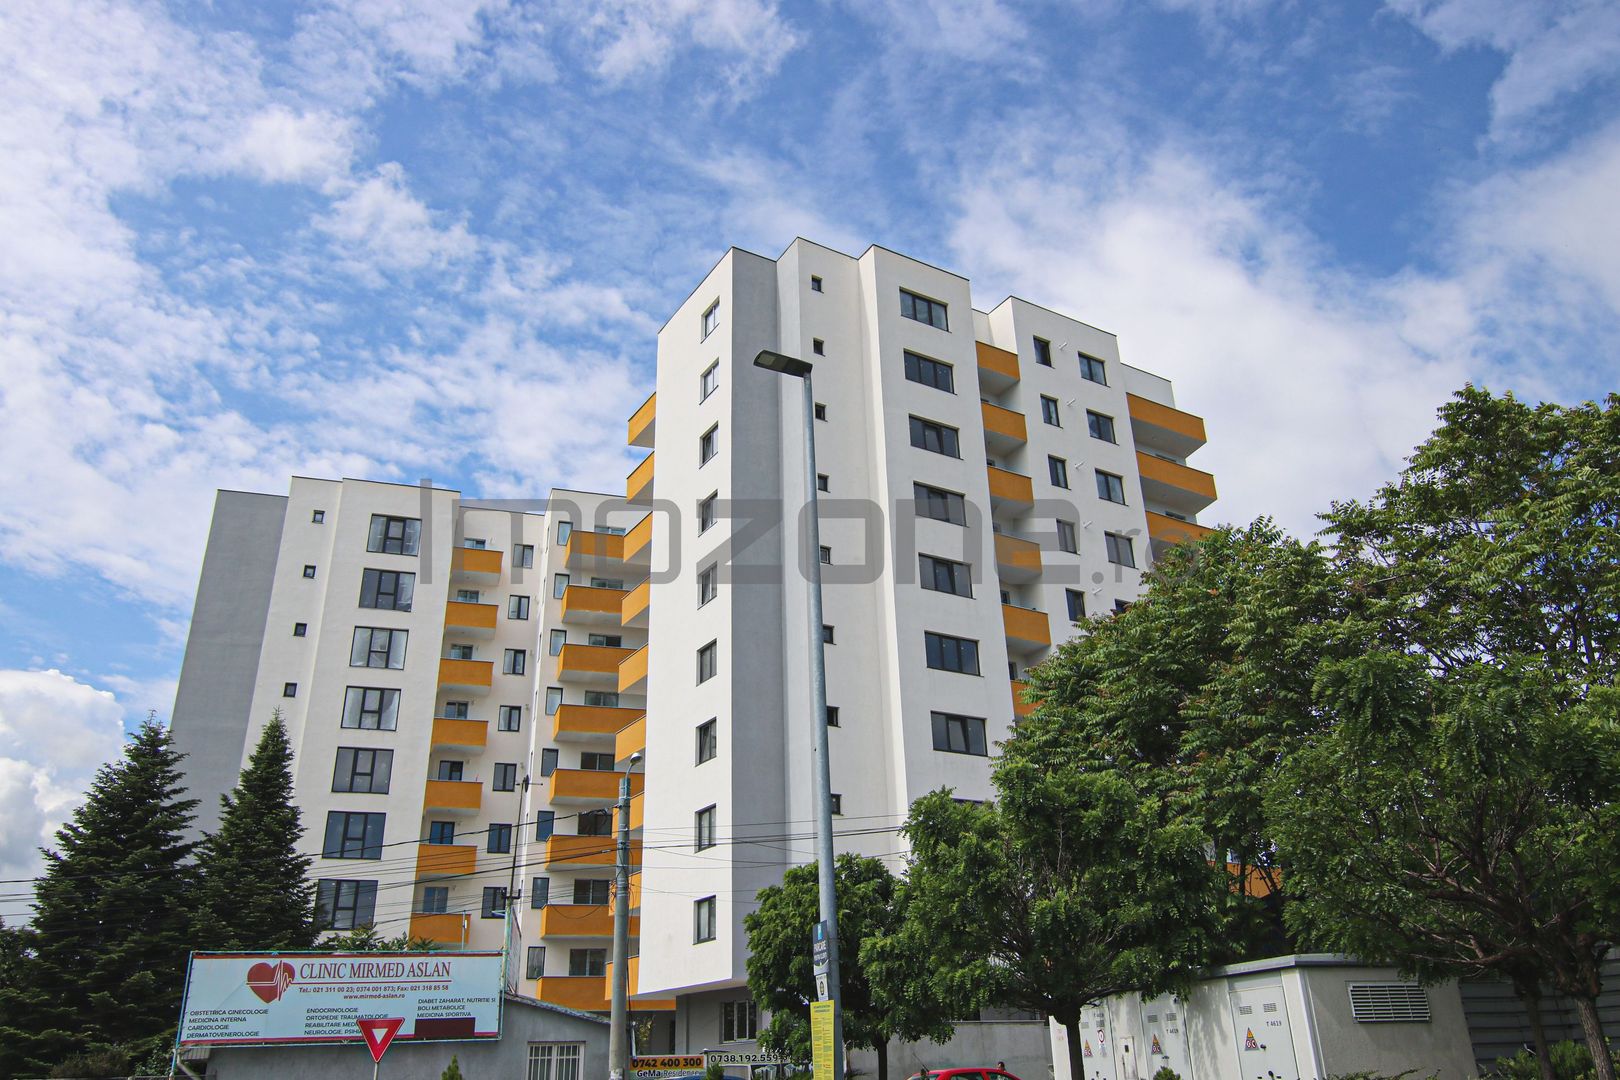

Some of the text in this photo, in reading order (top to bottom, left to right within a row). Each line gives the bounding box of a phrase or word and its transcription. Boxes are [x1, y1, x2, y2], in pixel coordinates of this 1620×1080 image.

[300, 961, 452, 979] CLINIC MIRMED ASLAN
[186, 1030, 260, 1039] DERMATOVENEROLOGIE
[632, 1057, 702, 1068] 0742 400 300
